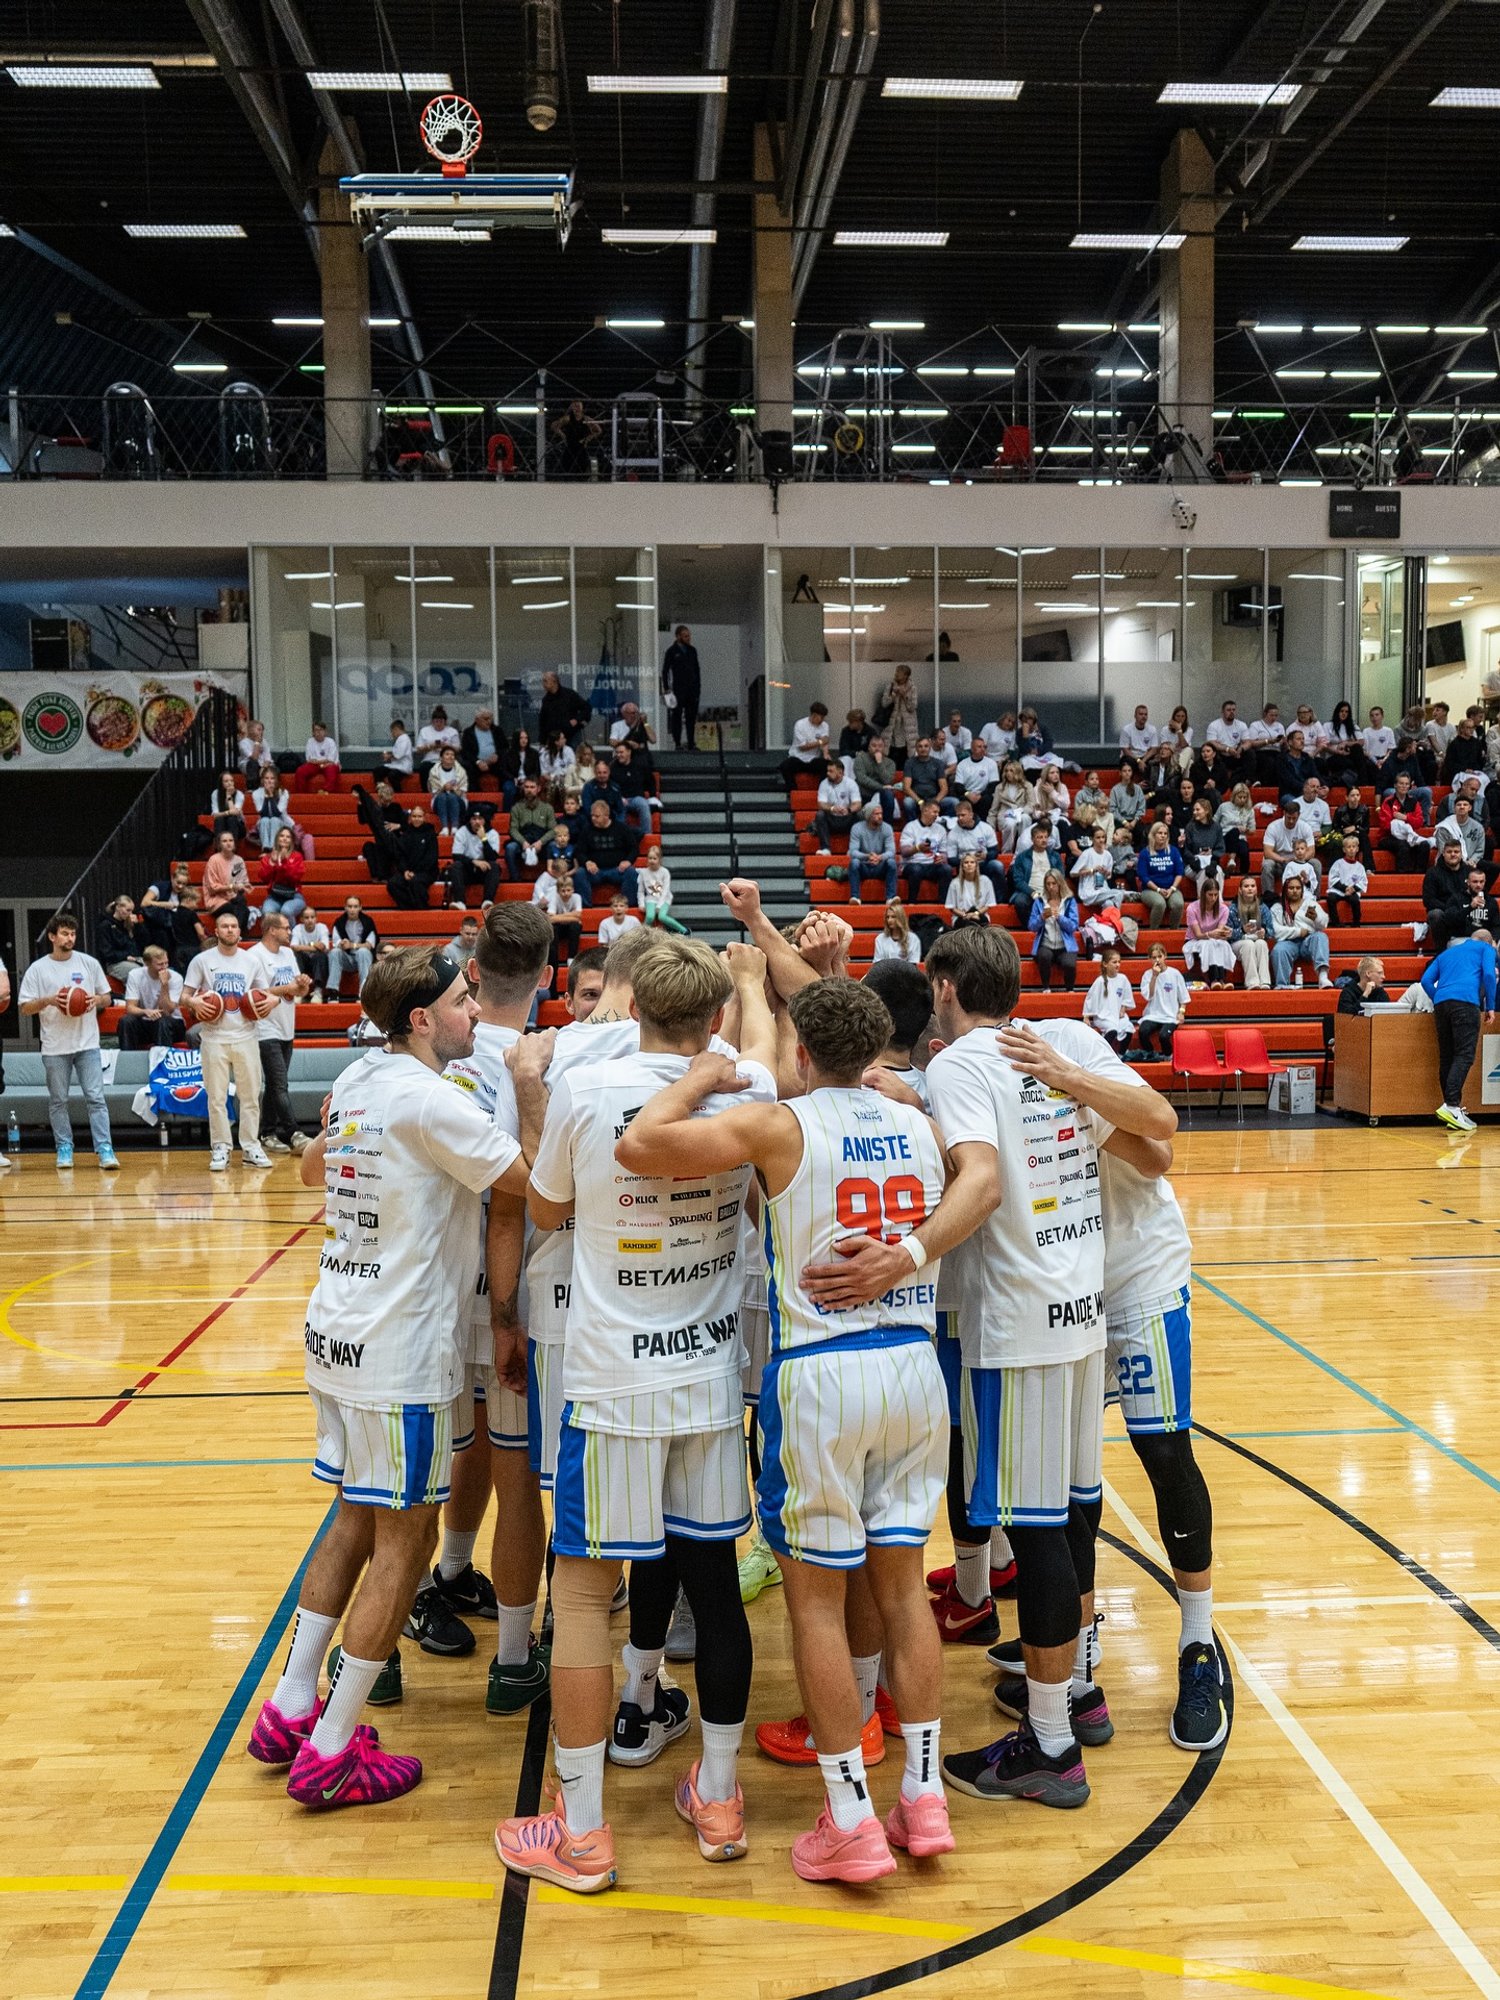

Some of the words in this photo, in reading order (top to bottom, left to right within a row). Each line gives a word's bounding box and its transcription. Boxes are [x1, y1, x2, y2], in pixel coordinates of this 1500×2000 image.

[852, 1110, 882, 1122] Viking
[1023, 1113, 1051, 1124] KVATRO
[842, 1134, 912, 1162] ANISTE
[1038, 1155, 1054, 1165] KLICK
[1059, 1170, 1083, 1185] SPALDING
[635, 1195, 658, 1204] KLICK
[669, 1211, 713, 1228] SPALDING
[836, 1174, 926, 1254] 99
[618, 1250, 736, 1287] BETMASTER
[1048, 1295, 1092, 1328] PAIDE
[330, 1338, 365, 1368] WAY
[633, 1322, 703, 1359] PAIDE
[1118, 1354, 1155, 1395] 22
